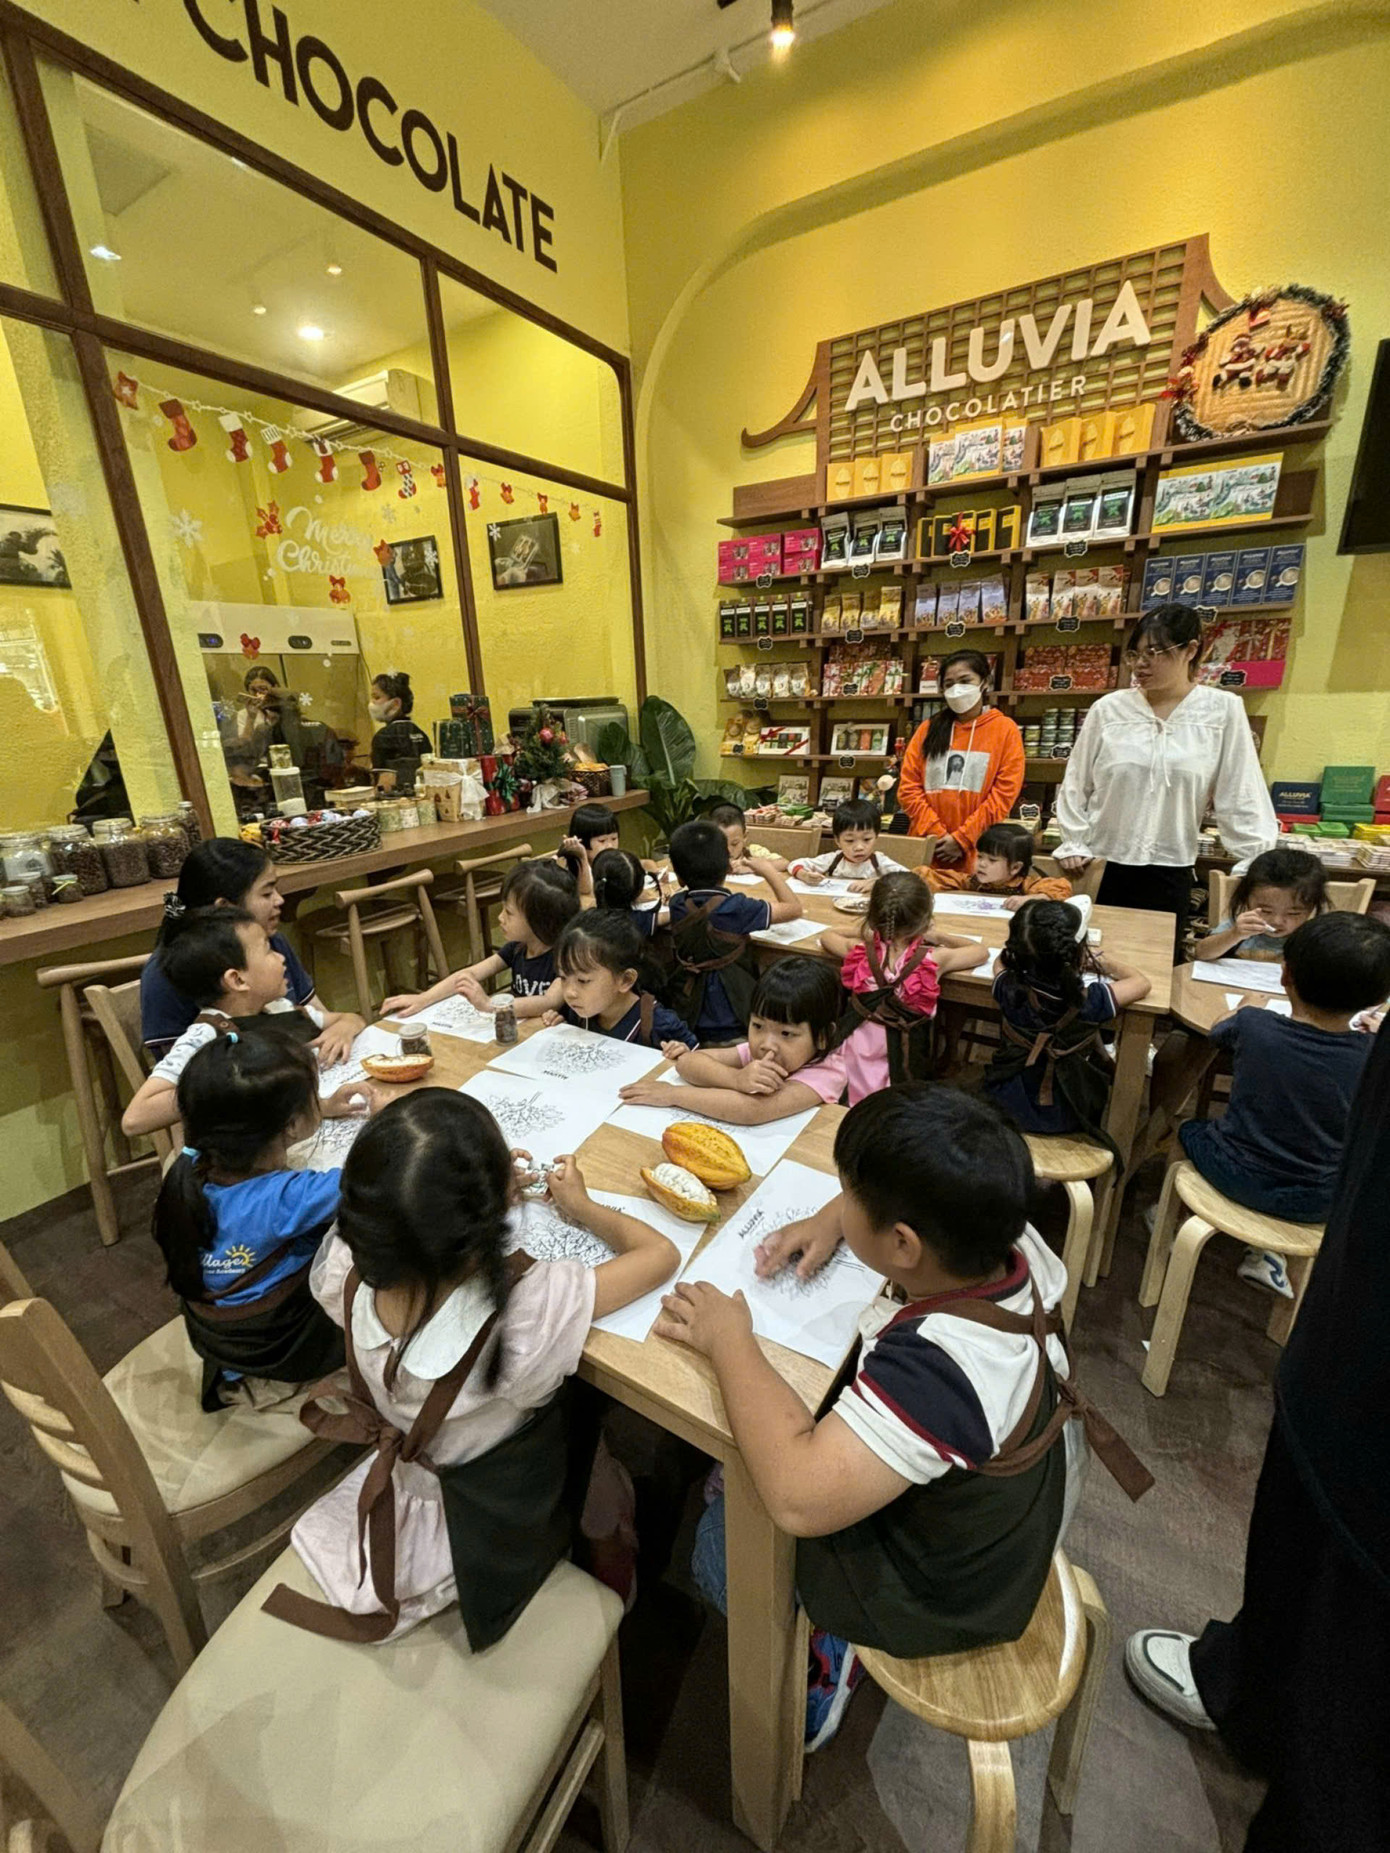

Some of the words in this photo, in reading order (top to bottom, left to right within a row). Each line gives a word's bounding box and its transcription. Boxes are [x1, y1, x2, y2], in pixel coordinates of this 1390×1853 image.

[183, 0, 557, 274] CHOCOLATE
[845, 280, 1151, 411] ALLUVIA
[890, 375, 1087, 433] CHOCOLATIER
